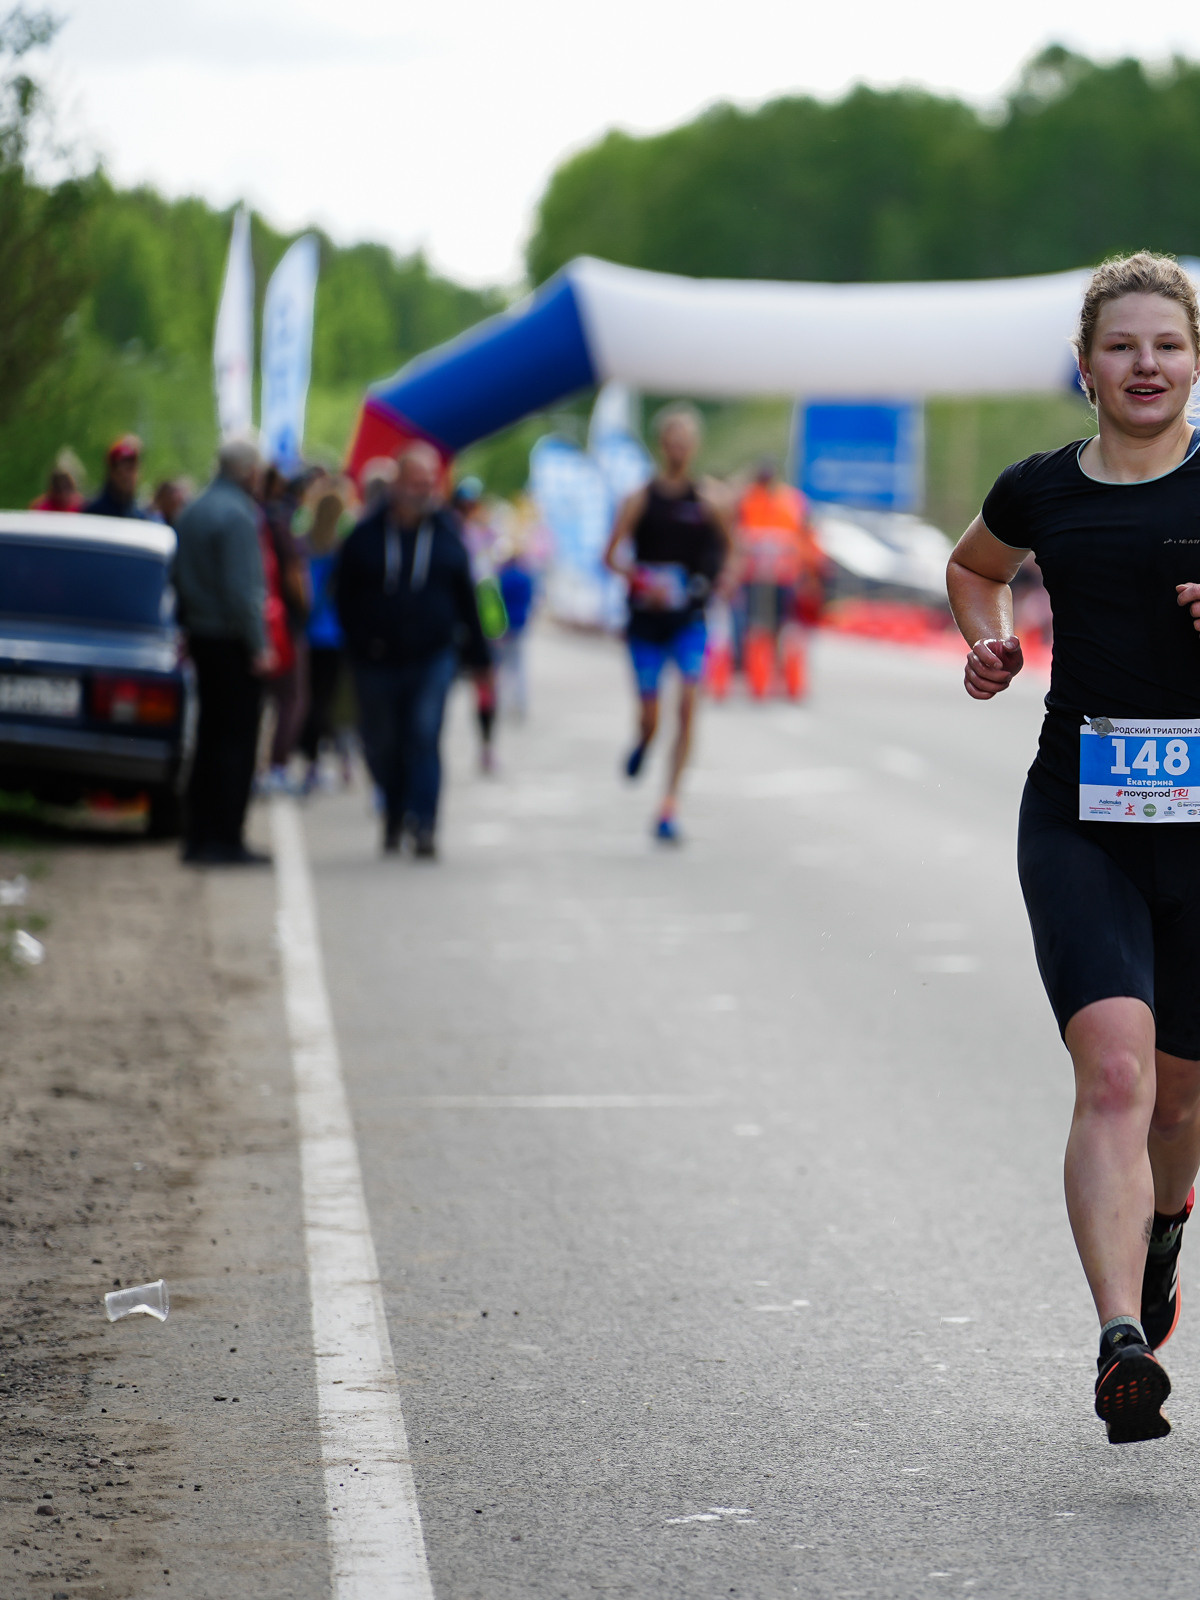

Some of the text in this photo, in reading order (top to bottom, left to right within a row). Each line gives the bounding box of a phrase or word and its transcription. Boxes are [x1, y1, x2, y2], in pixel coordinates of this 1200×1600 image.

[1152, 727, 1193, 735] ТРИАТЛОН
[1110, 738, 1191, 776] 148
[1126, 778, 1174, 788] Екатерина
